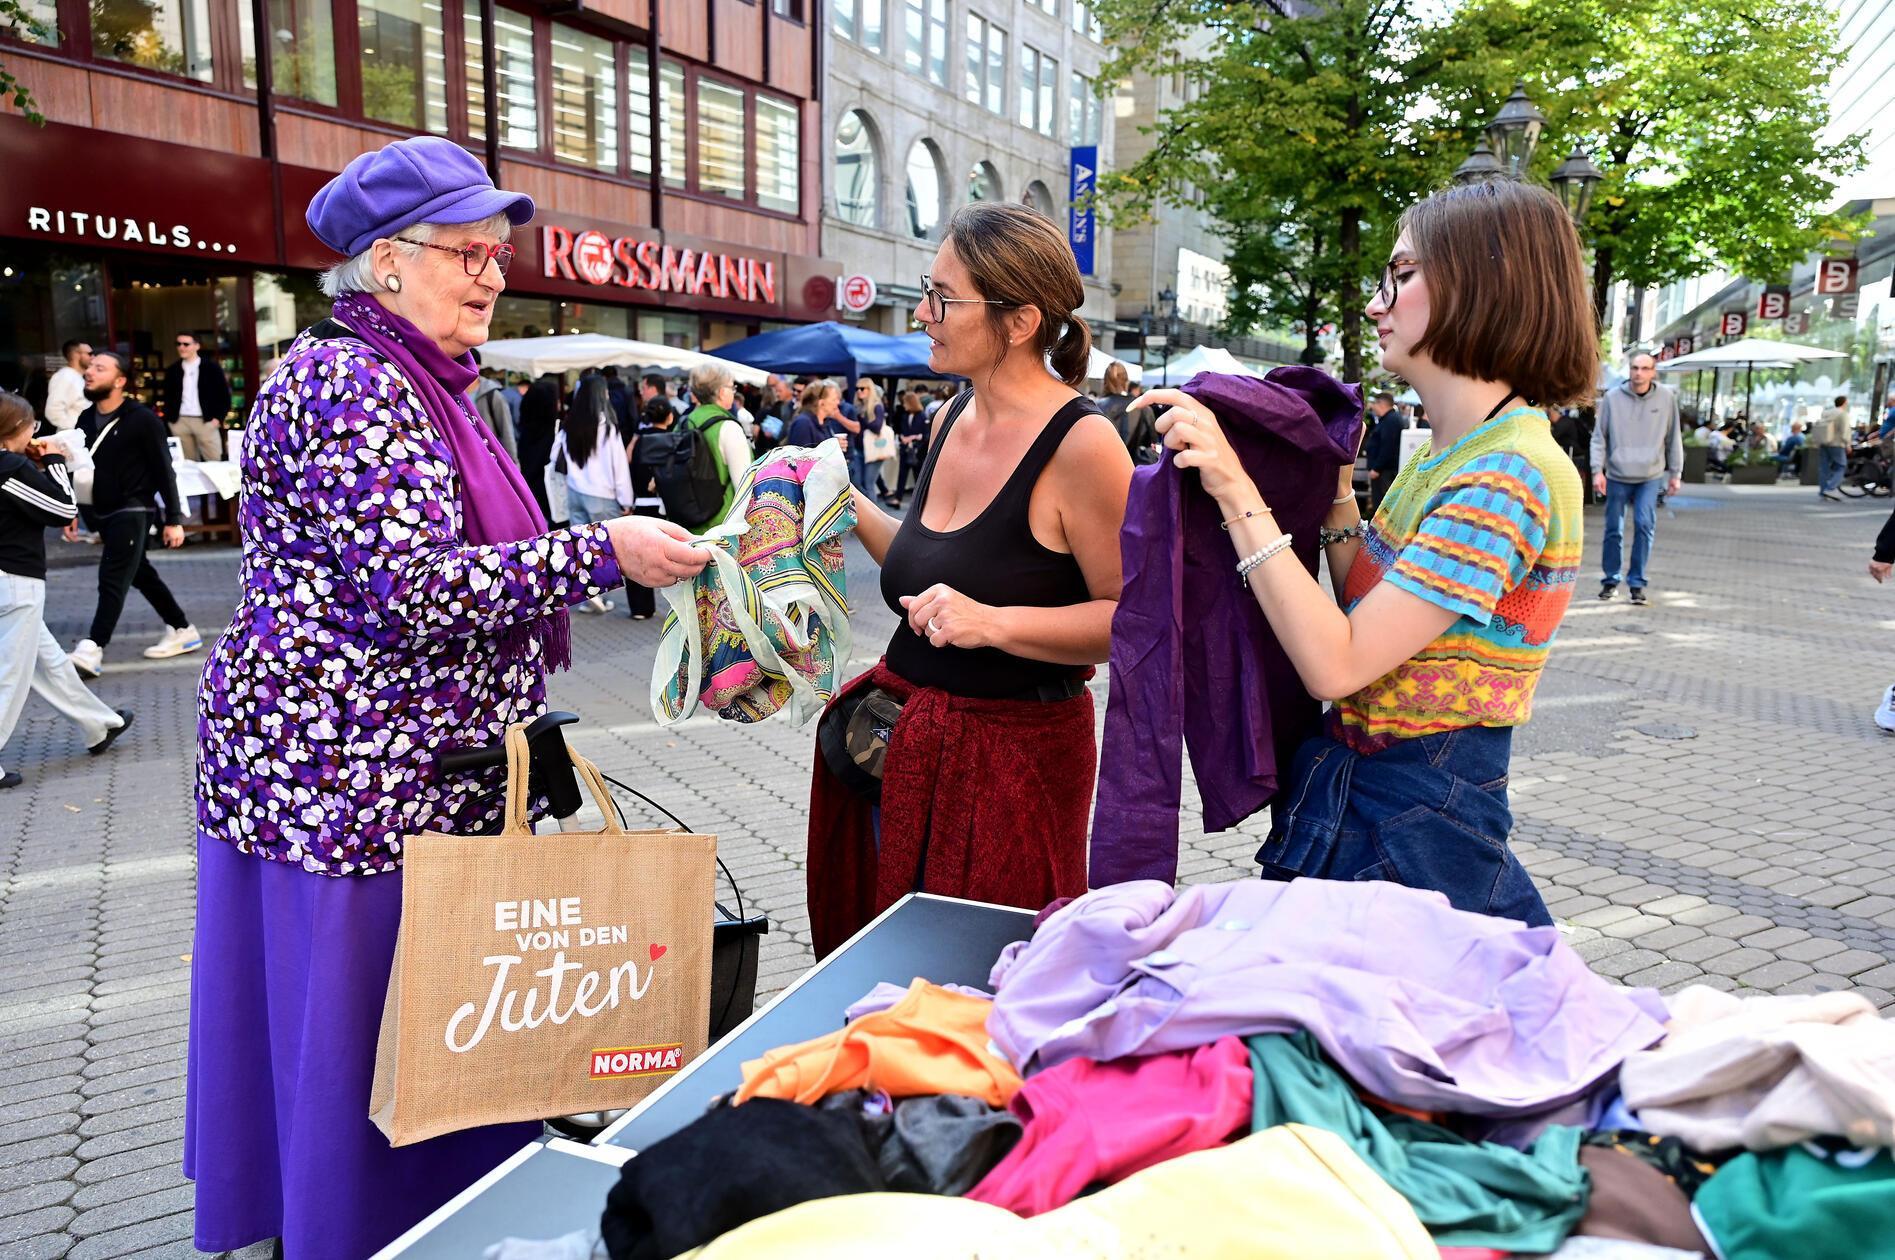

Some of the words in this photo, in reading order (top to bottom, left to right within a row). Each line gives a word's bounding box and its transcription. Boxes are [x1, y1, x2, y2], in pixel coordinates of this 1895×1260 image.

[542, 225, 775, 304] ROSSMANN
[495, 897, 582, 931] EINE
[515, 930, 570, 952] VON
[579, 925, 628, 947] DEN
[445, 951, 654, 1053] Juten
